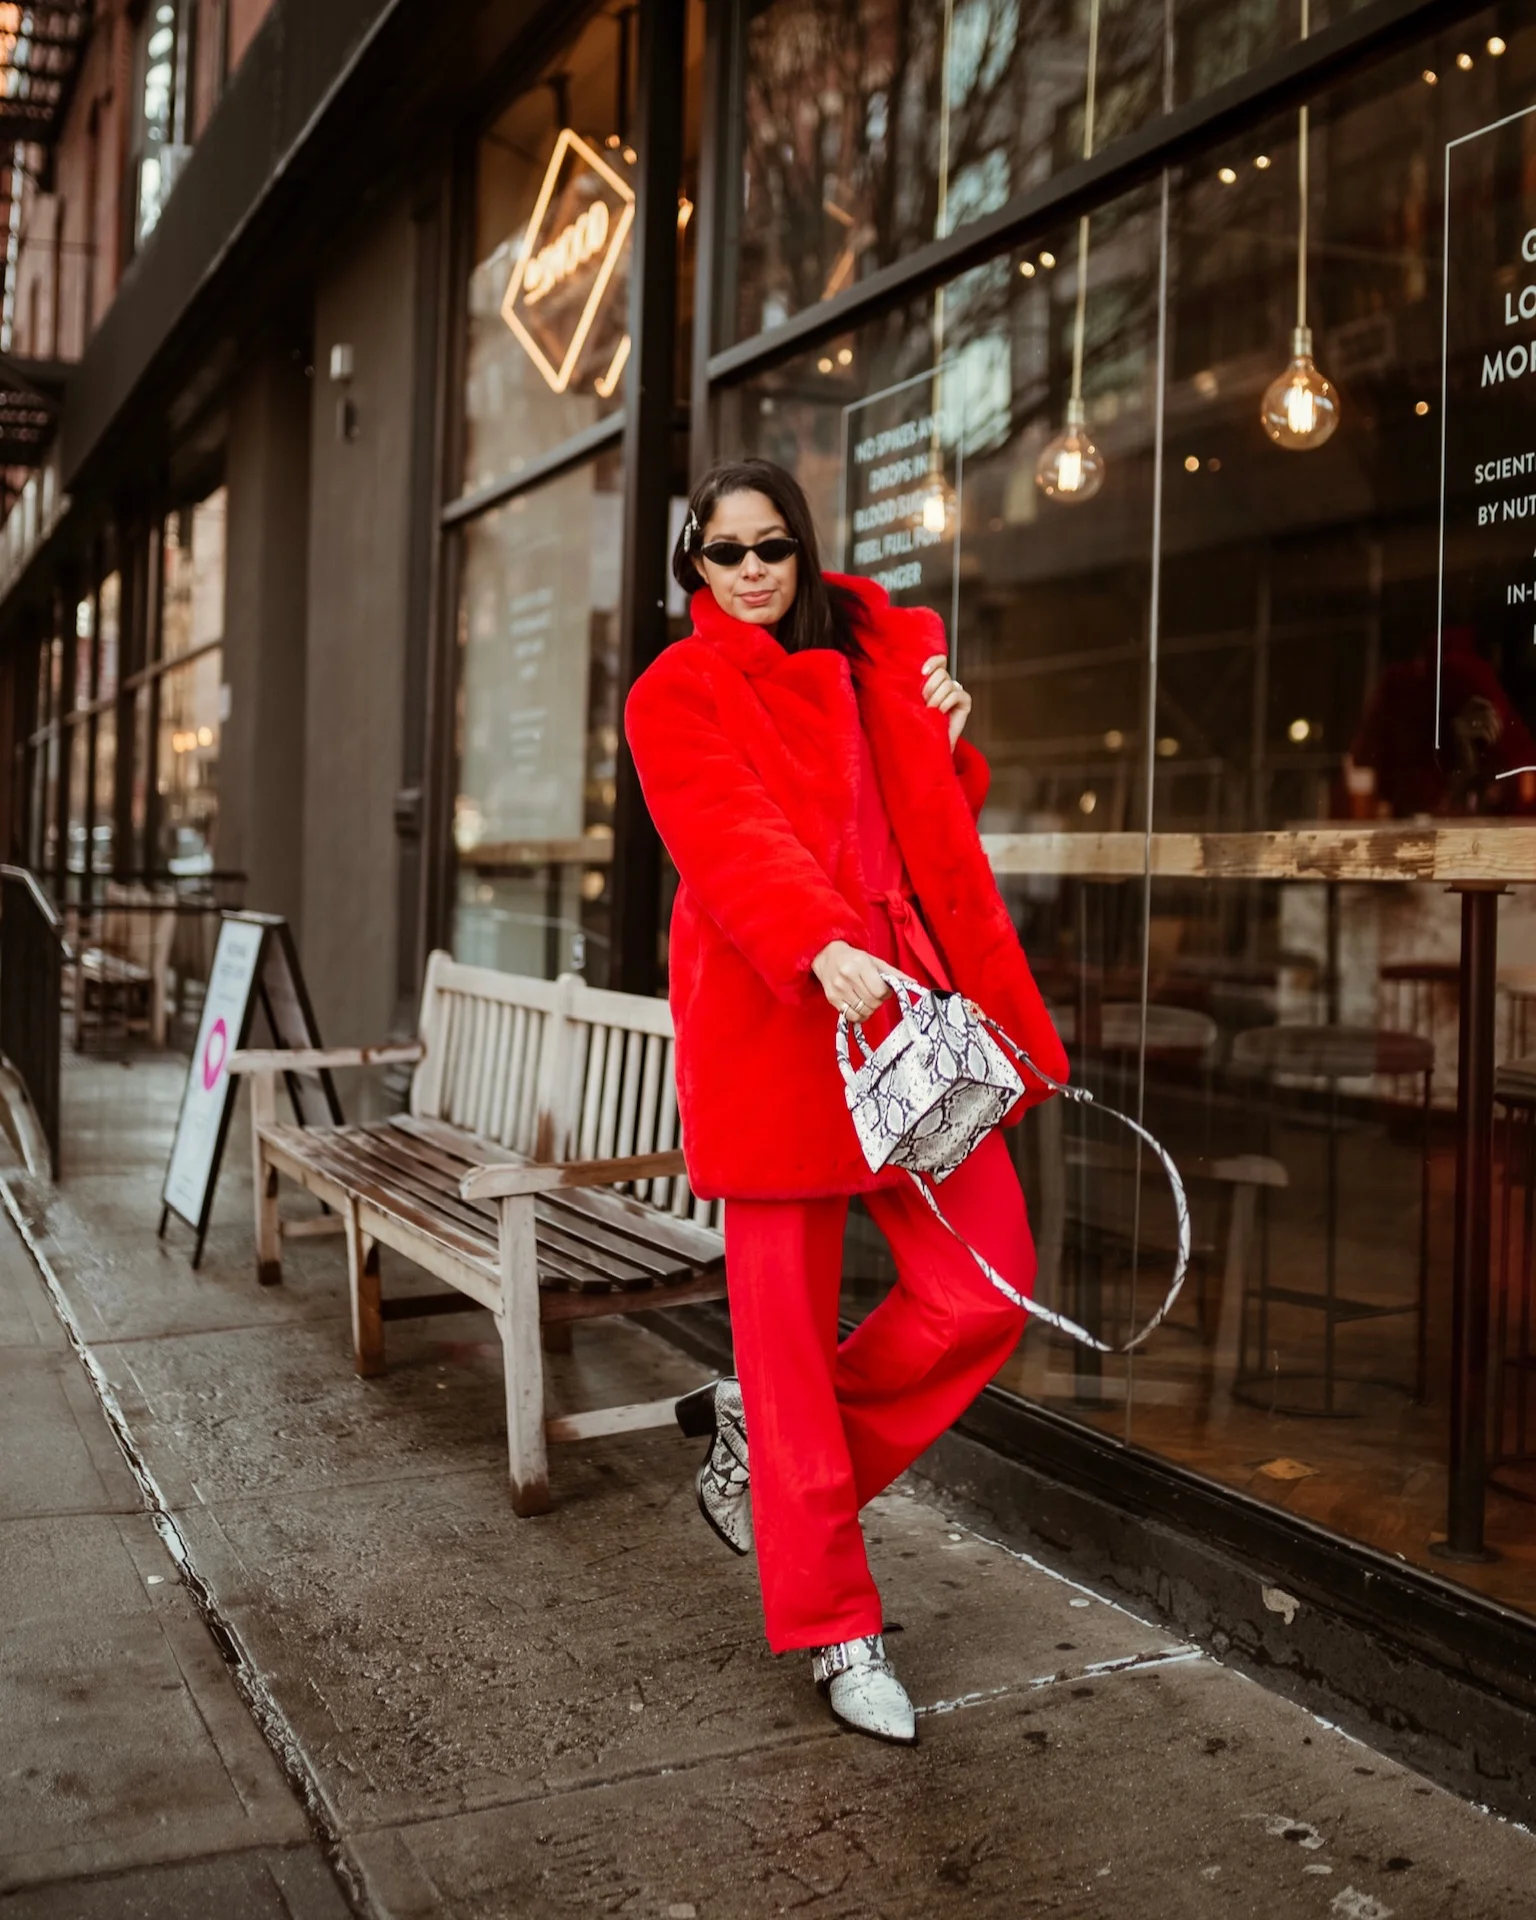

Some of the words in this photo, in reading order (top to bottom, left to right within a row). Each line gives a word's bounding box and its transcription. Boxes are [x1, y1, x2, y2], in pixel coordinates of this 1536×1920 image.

[1505, 285, 1536, 326] LO
[1474, 452, 1536, 484] SCIENT
[897, 485, 943, 518] SUG
[1478, 501, 1499, 526] BY
[869, 561, 922, 592] ONGER
